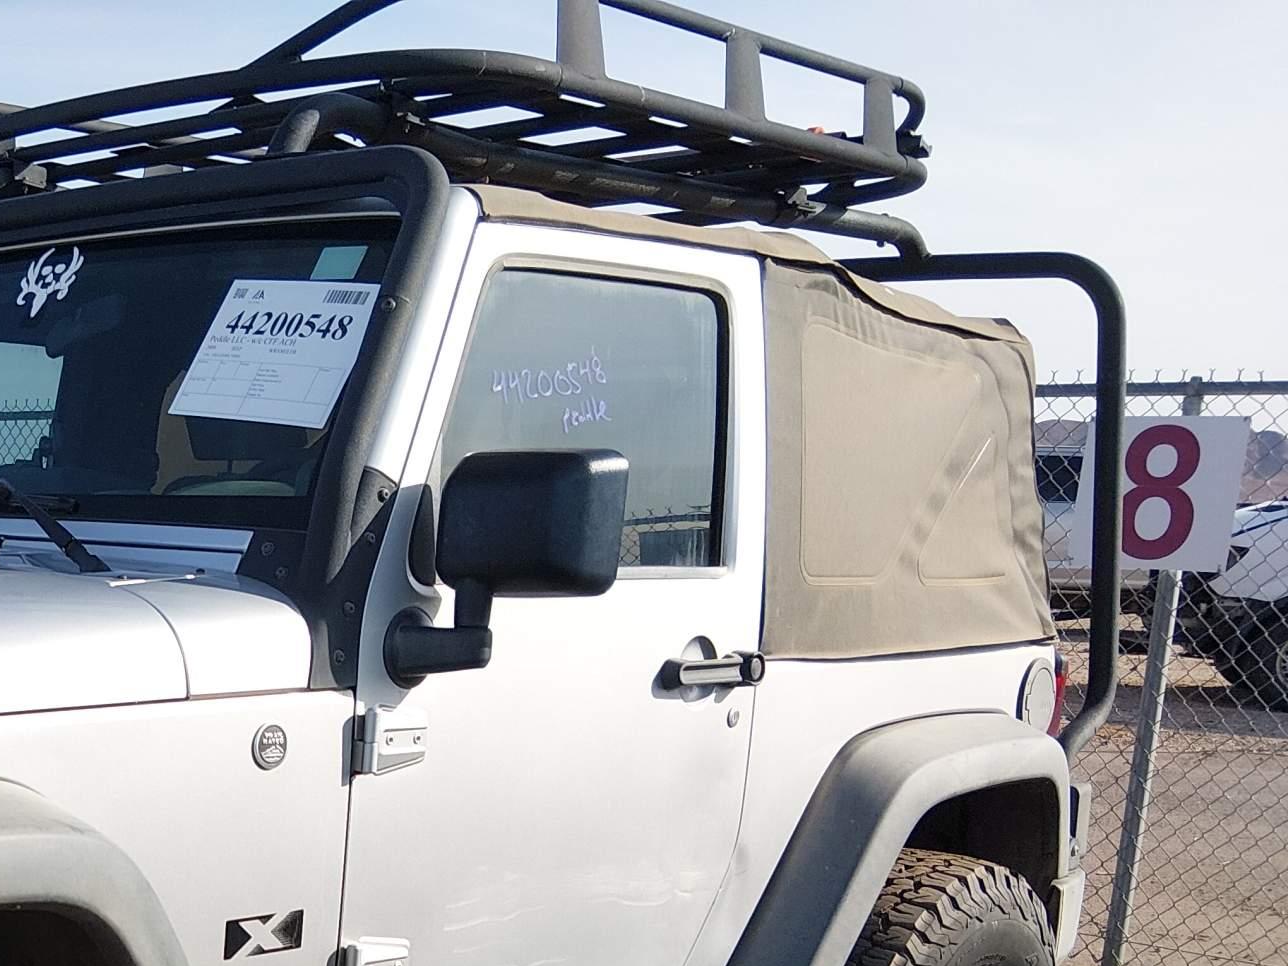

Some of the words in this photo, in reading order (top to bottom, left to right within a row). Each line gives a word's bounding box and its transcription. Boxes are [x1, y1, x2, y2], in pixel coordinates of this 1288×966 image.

[225, 310, 354, 341] 44200548
[491, 353, 607, 404] 44200548
[1121, 424, 1201, 560] 8
